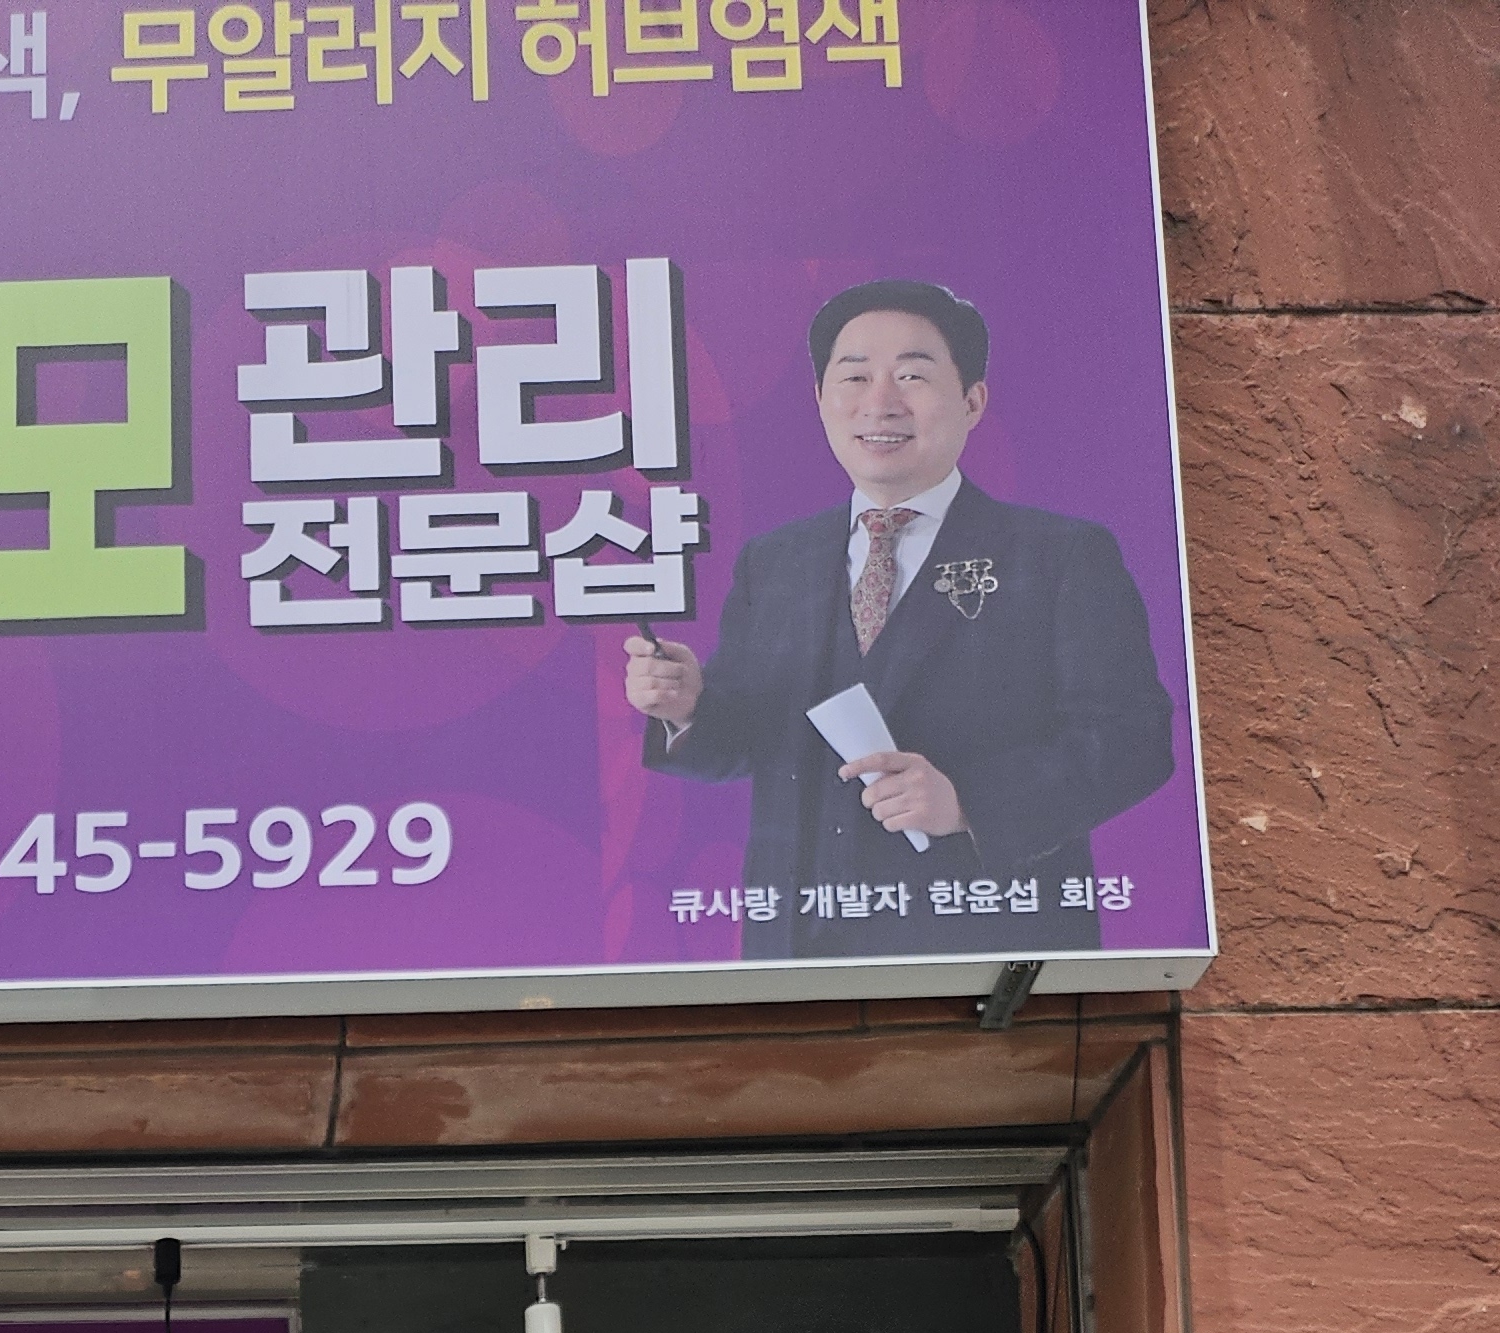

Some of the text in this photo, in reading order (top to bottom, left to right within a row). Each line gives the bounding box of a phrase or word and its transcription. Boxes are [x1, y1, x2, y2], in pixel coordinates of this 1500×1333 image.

[111, 0, 489, 114] 무알러지
[515, 0, 902, 98] 허브염색
[238, 257, 678, 482] 관리
[241, 487, 699, 627] 전문샵
[669, 875, 1135, 923] 큐사랑 개발자 한윤섭 회장
